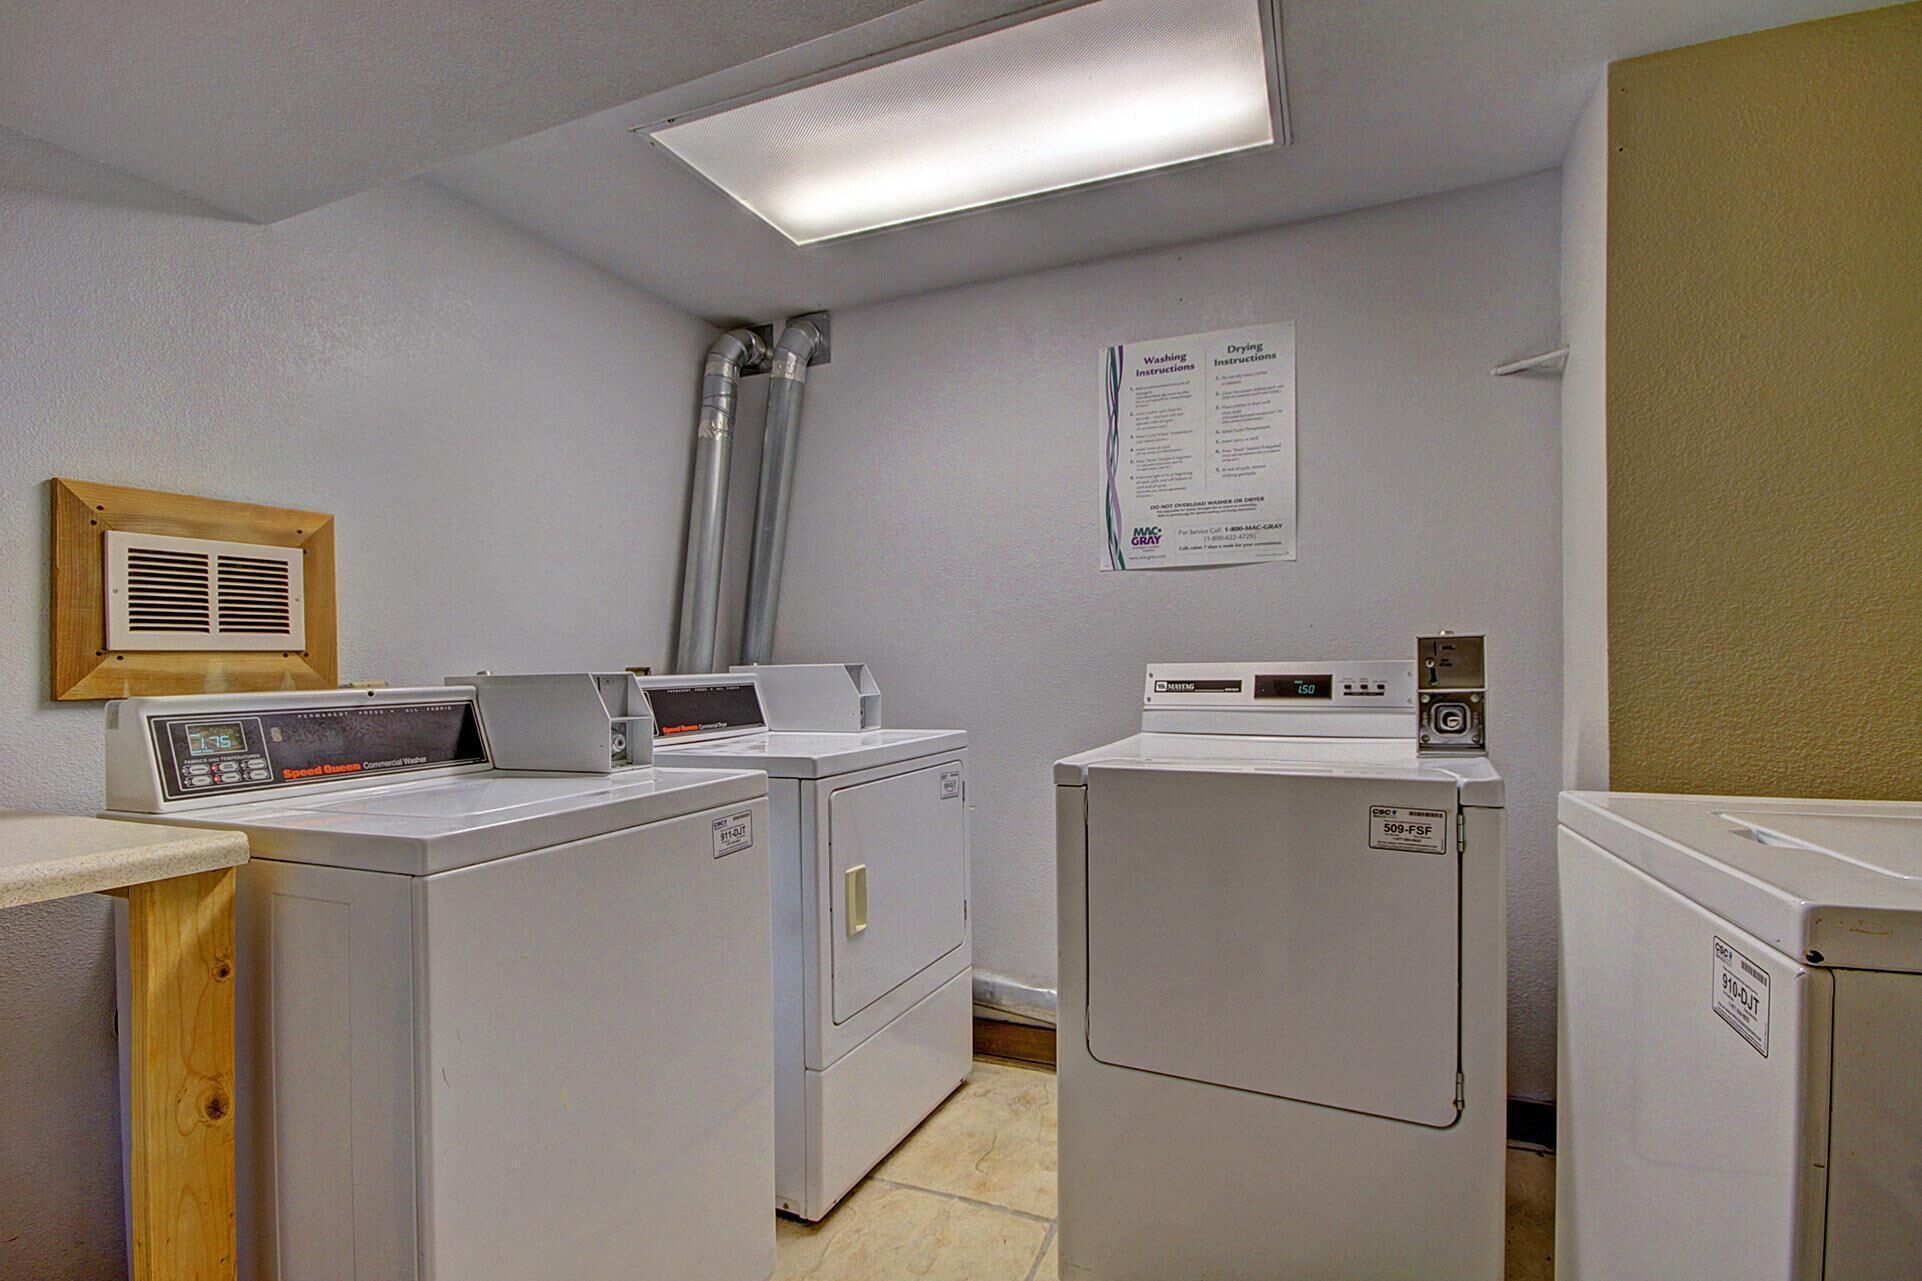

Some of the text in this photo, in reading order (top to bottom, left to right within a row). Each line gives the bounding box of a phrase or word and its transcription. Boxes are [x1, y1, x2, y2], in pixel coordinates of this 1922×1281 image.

[1227, 342, 1264, 355] Drying
[1143, 352, 1187, 365] Washing
[1213, 352, 1277, 367] Instructions
[1135, 363, 1196, 378] Instructions
[1161, 503, 1174, 511] NOT
[1174, 500, 1207, 509] OVERLOAD
[1207, 498, 1233, 506] WASHER
[1243, 496, 1265, 504] DRYER
[1189, 527, 1208, 535] Service
[1224, 522, 1284, 532] 1-800-MAC-GRAY
[1131, 535, 1162, 546] GRAY
[1167, 683, 1195, 691] MAYTAG
[297, 711, 349, 719] PERMANENT
[220, 753, 261, 762] TEMPERATURES
[282, 756, 427, 779] Speed Queen Commercial Washer
[720, 826, 745, 841] 911-DJT
[1384, 824, 1432, 835] 509-FSF
[1715, 942, 1729, 957] CSC
[1722, 973, 1760, 1016] 910-DJT
